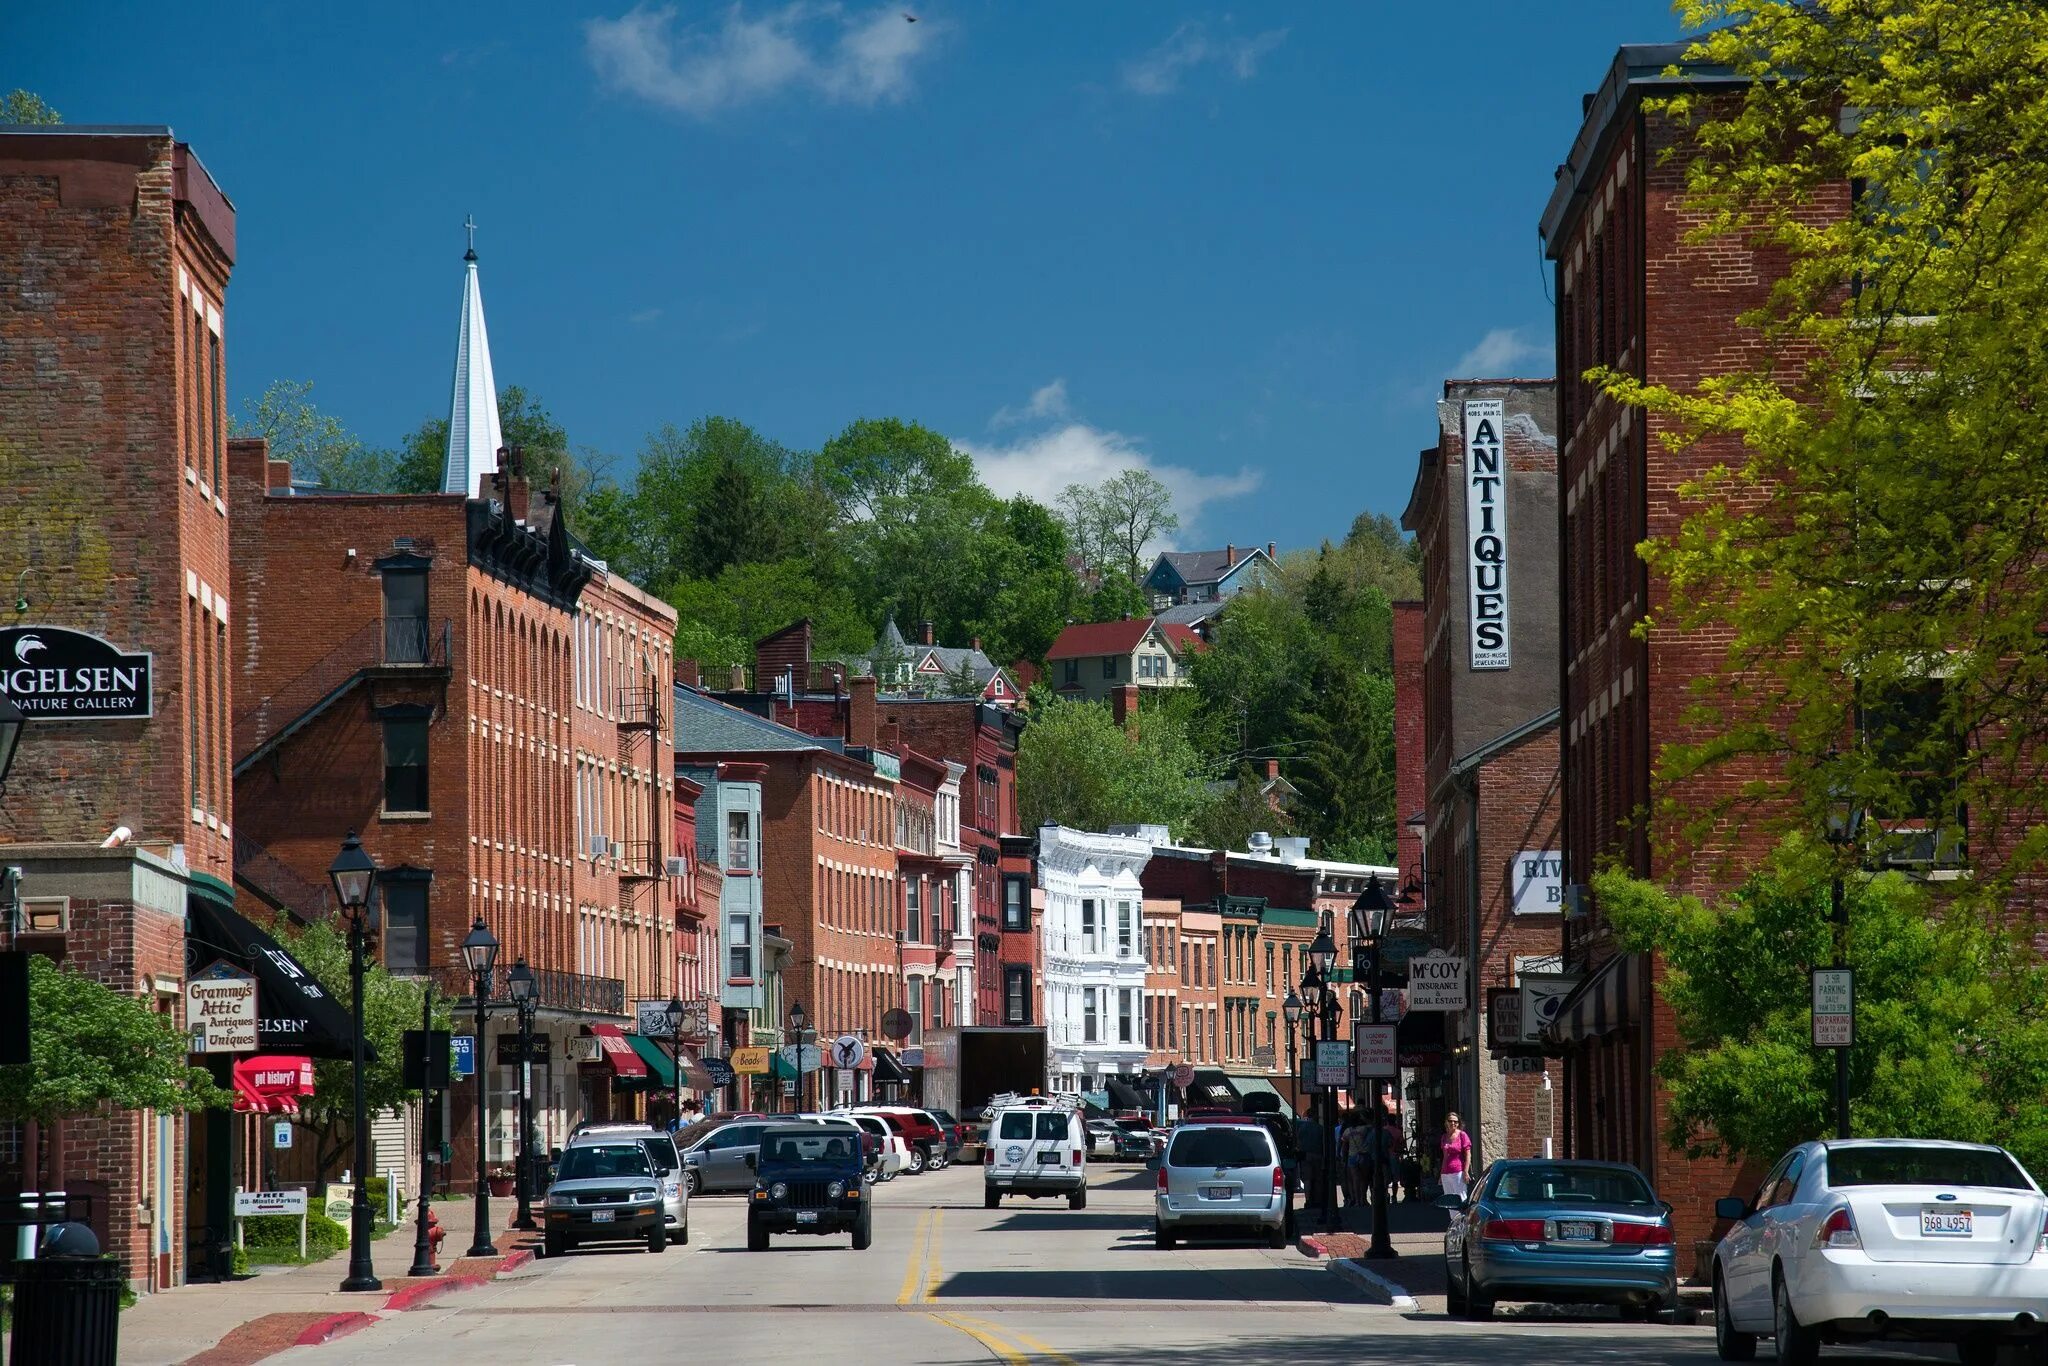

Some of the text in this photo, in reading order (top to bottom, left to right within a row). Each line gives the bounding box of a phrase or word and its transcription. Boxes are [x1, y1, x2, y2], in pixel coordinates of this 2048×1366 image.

[1472, 419, 1504, 650] ANTIQUES
[11, 696, 136, 710] NATURE GALLERY
[1412, 962, 1462, 979] McCOY
[190, 982, 252, 1000] Grammy's
[1819, 986, 1846, 994] PARKING
[200, 1000, 242, 1015] Attic
[209, 1017, 253, 1029] Antiques
[1816, 1016, 1849, 1024] NO PARKING
[209, 1034, 254, 1048] Uniques
[740, 1053, 760, 1065] Beads
[1504, 1060, 1538, 1071] OPEN
[255, 1071, 266, 1087] got
[267, 1071, 295, 1086] history?
[1925, 1217, 1971, 1230] 968 4957
